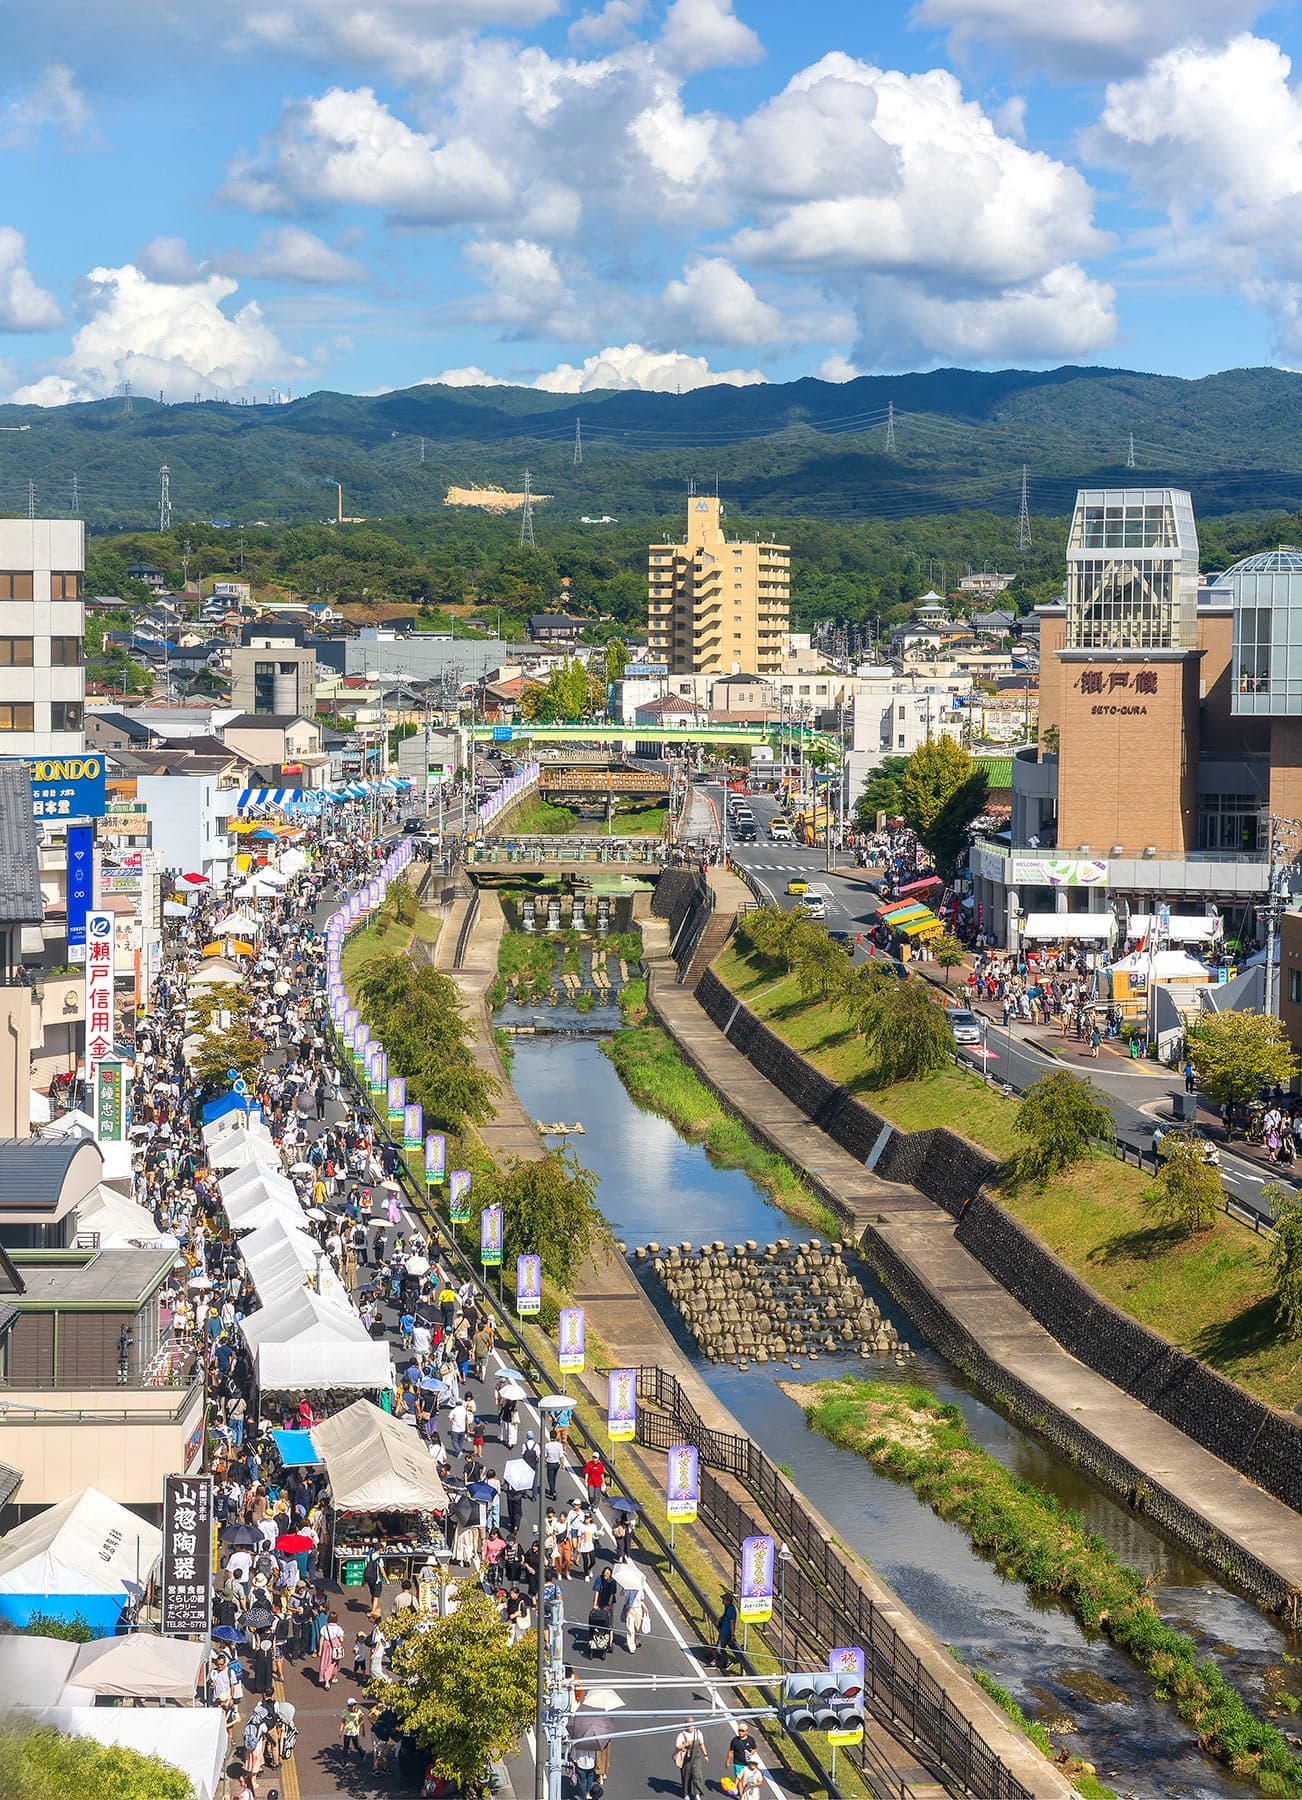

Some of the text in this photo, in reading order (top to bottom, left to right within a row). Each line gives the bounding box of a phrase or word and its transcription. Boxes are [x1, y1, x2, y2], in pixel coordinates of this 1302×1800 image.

[1080, 670, 1158, 695] 瀬戸蔵
[89, 941, 111, 1080] 瀬戸信用金
[173, 1482, 197, 1580] 山惣陶器
